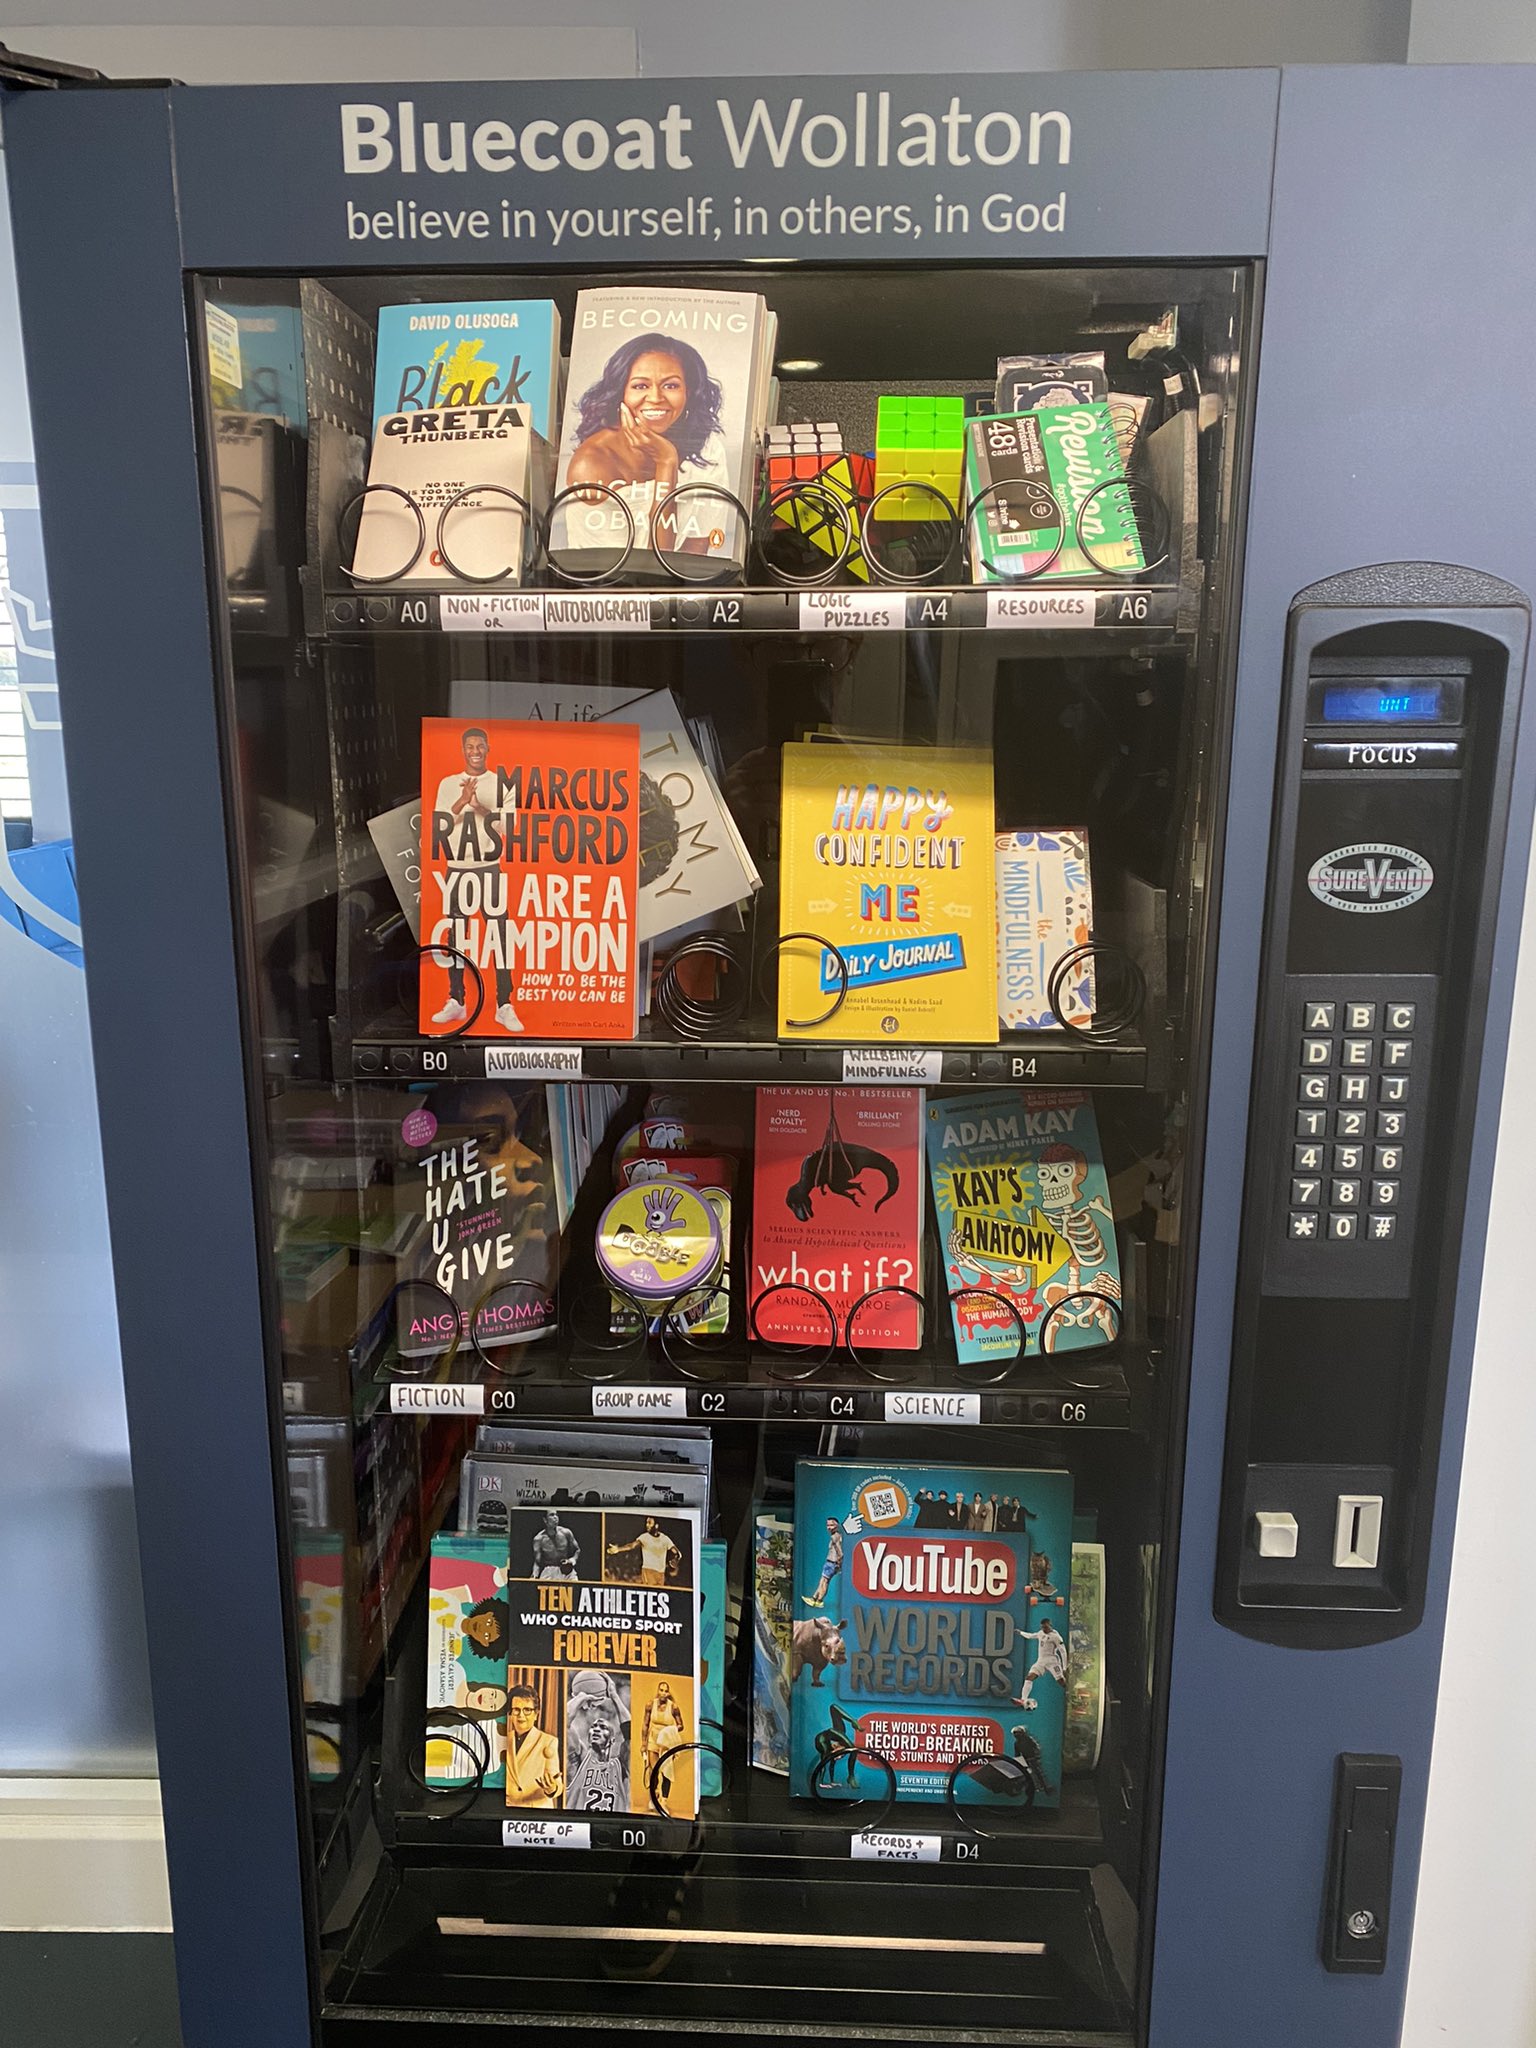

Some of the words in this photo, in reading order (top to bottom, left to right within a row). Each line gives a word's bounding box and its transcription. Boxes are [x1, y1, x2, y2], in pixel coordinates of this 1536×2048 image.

[341, 102, 693, 174] Bluecoat
[716, 91, 1072, 169] Wollaton
[347, 199, 490, 240] believe
[500, 198, 537, 238] in
[545, 195, 722, 246] yourself,
[733, 196, 769, 235] in
[778, 194, 923, 240] others,
[934, 194, 969, 233] in
[980, 191, 1067, 233] God
[409, 314, 451, 332] DAVID
[454, 312, 519, 330] OLUSOGA
[581, 308, 749, 333] BECOMING
[396, 354, 532, 413] Black
[383, 407, 525, 437] GRETA
[400, 428, 508, 445] THUNBERG
[987, 421, 1017, 449] 48
[1016, 418, 1029, 452] Revision
[1025, 416, 1043, 462] Presentation
[990, 446, 1019, 457] cards
[1022, 452, 1034, 474] cards
[1045, 410, 1106, 542] Revision
[584, 509, 701, 537] OBAMA
[808, 592, 853, 609] LOGIC
[920, 598, 949, 622] A4
[997, 597, 1085, 616] RESOURCES
[1118, 596, 1149, 620] A6
[400, 600, 428, 624] A0
[546, 599, 651, 625] AUTOBIOGRAPHY
[712, 600, 741, 624] A2
[824, 610, 891, 628] PUZZLES
[484, 617, 503, 629] OR
[528, 701, 544, 721] A
[496, 765, 630, 811] MARCUS
[431, 810, 630, 865] RASHFORD
[813, 832, 966, 870] CONFIDENT
[431, 871, 508, 918] YOU
[517, 873, 592, 919] ARE
[601, 876, 628, 920] A
[859, 882, 921, 923] ME
[1002, 860, 1034, 1001] MINDFULNESS
[431, 917, 627, 973] CHAMPION
[878, 940, 954, 972] JOURNAL
[521, 973, 553, 987] HOW
[557, 973, 575, 987] TO
[580, 974, 597, 988] BE
[600, 974, 626, 988] THE
[516, 987, 549, 1002] BEST
[550, 988, 576, 1002] YOU
[578, 989, 607, 1003] CAN
[610, 990, 626, 1004] BE
[1311, 1007, 1330, 1028] A
[1352, 1008, 1370, 1028] B
[1392, 1008, 1411, 1029] C
[422, 1051, 448, 1071] B0
[487, 1051, 580, 1072] AUTOBIOGRAPHY
[1309, 1043, 1328, 1063] D
[1350, 1043, 1367, 1063] E
[1390, 1043, 1407, 1064] F
[845, 1065, 927, 1079] MINDFULNESS
[1011, 1057, 1037, 1078] B4
[762, 1087, 777, 1095] THE
[780, 1087, 792, 1095] UK
[794, 1088, 814, 1096] AND
[817, 1088, 829, 1097] US
[860, 1089, 912, 1099] BESTSELLER
[1306, 1079, 1324, 1098] G
[1346, 1079, 1365, 1099] H
[1389, 1079, 1404, 1099] J
[941, 1115, 1020, 1149] ADAM
[1024, 1107, 1078, 1137] KAY
[1306, 1114, 1318, 1133] 1
[1344, 1114, 1360, 1134] 2
[1385, 1115, 1400, 1134] 3
[418, 1138, 479, 1187] THE
[1301, 1148, 1317, 1168] 4
[1341, 1149, 1357, 1168] 5
[1381, 1150, 1397, 1169] 6
[425, 1163, 508, 1222] HATE
[952, 1166, 1024, 1209] KAY'S
[1299, 1183, 1315, 1202] 7
[1338, 1183, 1354, 1203] 8
[1379, 1184, 1394, 1204] 9
[477, 1217, 502, 1234] GREEN
[768, 1226, 804, 1234] SERIOUS
[807, 1228, 857, 1237] SCIENTIFIC
[860, 1230, 900, 1238] ANSWERS
[1335, 1217, 1351, 1237] 0
[432, 1218, 449, 1255] U
[772, 1235, 801, 1246] Absurd
[804, 1237, 861, 1249] Hypothetical
[863, 1240, 907, 1251] Questions
[961, 1216, 1056, 1266] ANATOMY
[436, 1232, 514, 1295] GIVE
[757, 1250, 853, 1293] what
[863, 1256, 913, 1296] if?
[477, 1298, 555, 1326] THOMAS
[1017, 1297, 1028, 1306] TO
[965, 1312, 980, 1322] THE
[982, 1309, 1011, 1321] HUMAN
[851, 1328, 901, 1337] EDITION
[397, 1386, 466, 1408] FICTION
[491, 1390, 516, 1410] C0
[595, 1393, 634, 1408] GROUP
[637, 1393, 673, 1408] GAME
[701, 1393, 726, 1412] C2
[830, 1396, 855, 1416] C4
[893, 1395, 966, 1418] SCIENCE
[1061, 1402, 1087, 1421] C6
[480, 1477, 500, 1490] DK
[525, 1479, 540, 1489] THE
[516, 1489, 547, 1500] WIZARD
[861, 1540, 1008, 1597] YouTube
[537, 1584, 573, 1612] TEN
[577, 1586, 670, 1618] ATHLETES
[520, 1613, 559, 1628] WHO
[561, 1614, 632, 1631] CHANGED
[634, 1619, 683, 1635] SPORT
[853, 1605, 1015, 1657] WORLD
[553, 1629, 658, 1669] FOREVER
[850, 1650, 1014, 1698] RECORDS
[869, 1720, 888, 1733] THE
[891, 1720, 937, 1735] WORLD'S
[940, 1723, 990, 1737] GREATEST
[865, 1733, 994, 1754] RECORD-BREAKING
[904, 1751, 934, 1763] STUNTS
[936, 1753, 954, 1764] AND
[900, 1776, 928, 1784] SEVENTH
[507, 1821, 548, 1836] PEOPLE
[557, 1823, 573, 1836] OF
[623, 1830, 646, 1847] D0
[524, 1836, 557, 1846] NOTE
[860, 1834, 913, 1849] RECORDS
[877, 1849, 919, 1861] FACTS
[956, 1843, 979, 1861] D4
